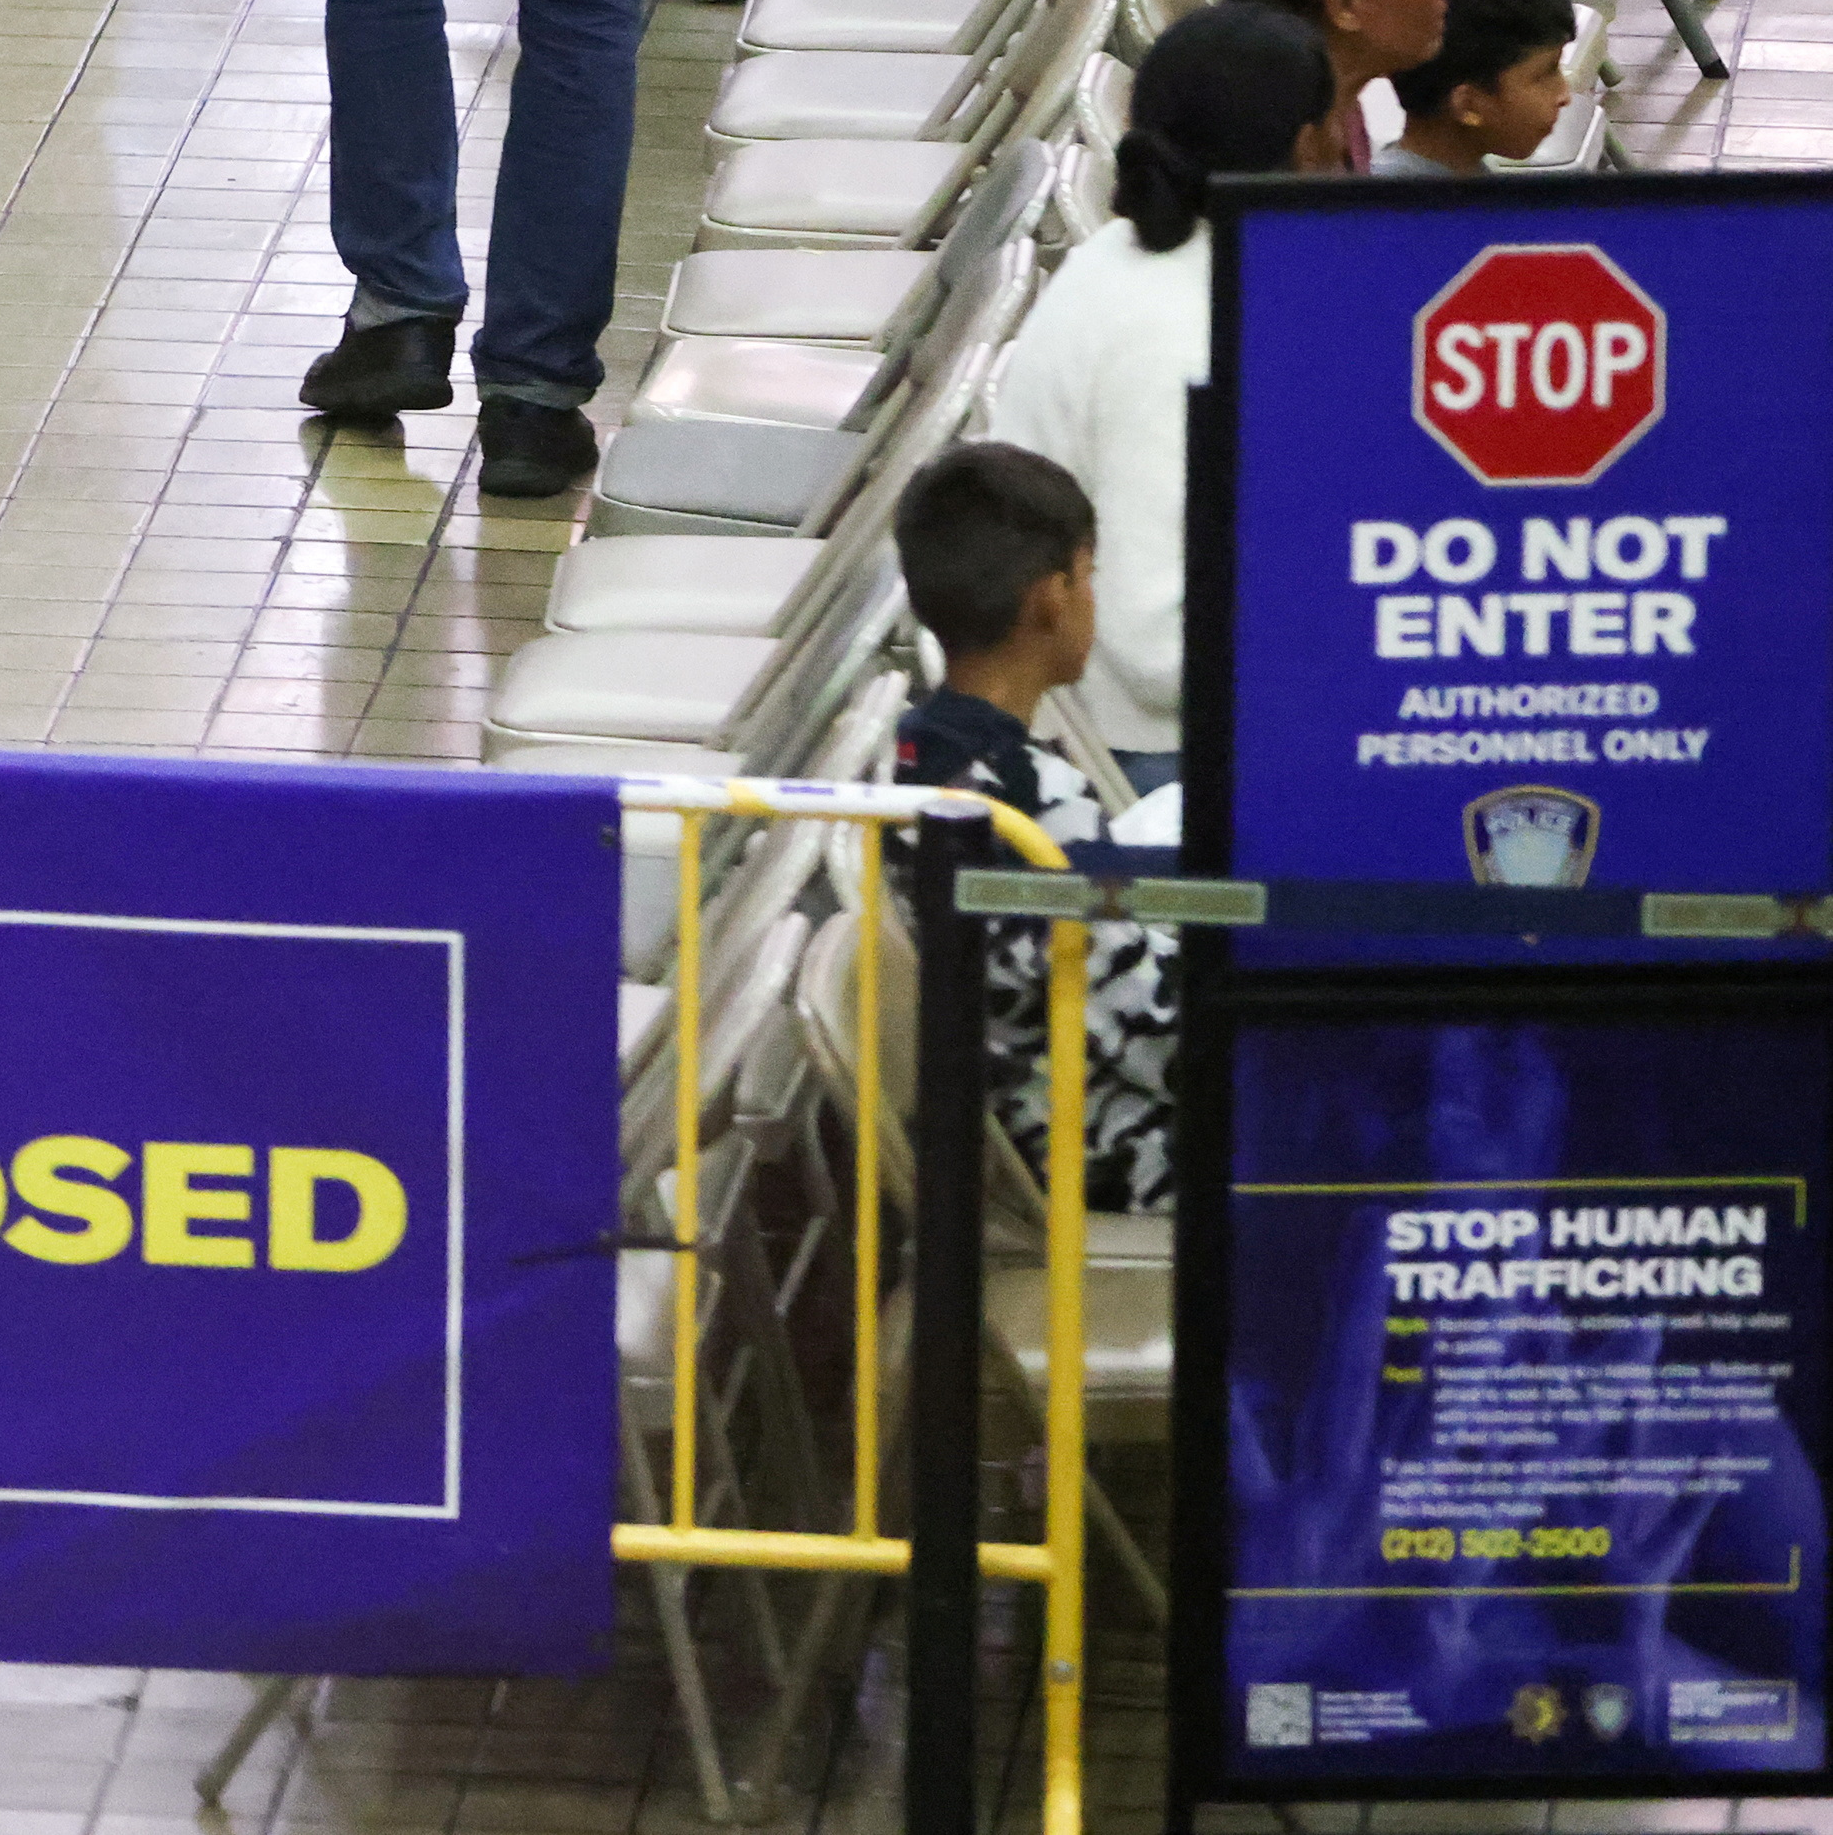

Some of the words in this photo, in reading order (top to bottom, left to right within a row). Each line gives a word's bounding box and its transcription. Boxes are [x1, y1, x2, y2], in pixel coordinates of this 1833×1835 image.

[1431, 320, 1648, 411] STOP
[1350, 519, 1496, 585] DO
[1521, 515, 1726, 581] NOT
[1374, 592, 1696, 659] ENTER
[1398, 683, 1660, 720] AUTHORIZED
[1356, 730, 1597, 767] PERSONNEL
[1602, 728, 1708, 764] ONLY
[1386, 1209, 1539, 1252] STOP
[1550, 1206, 1766, 1247] HUMAN
[1384, 1255, 1764, 1301] TRAFFICKING
